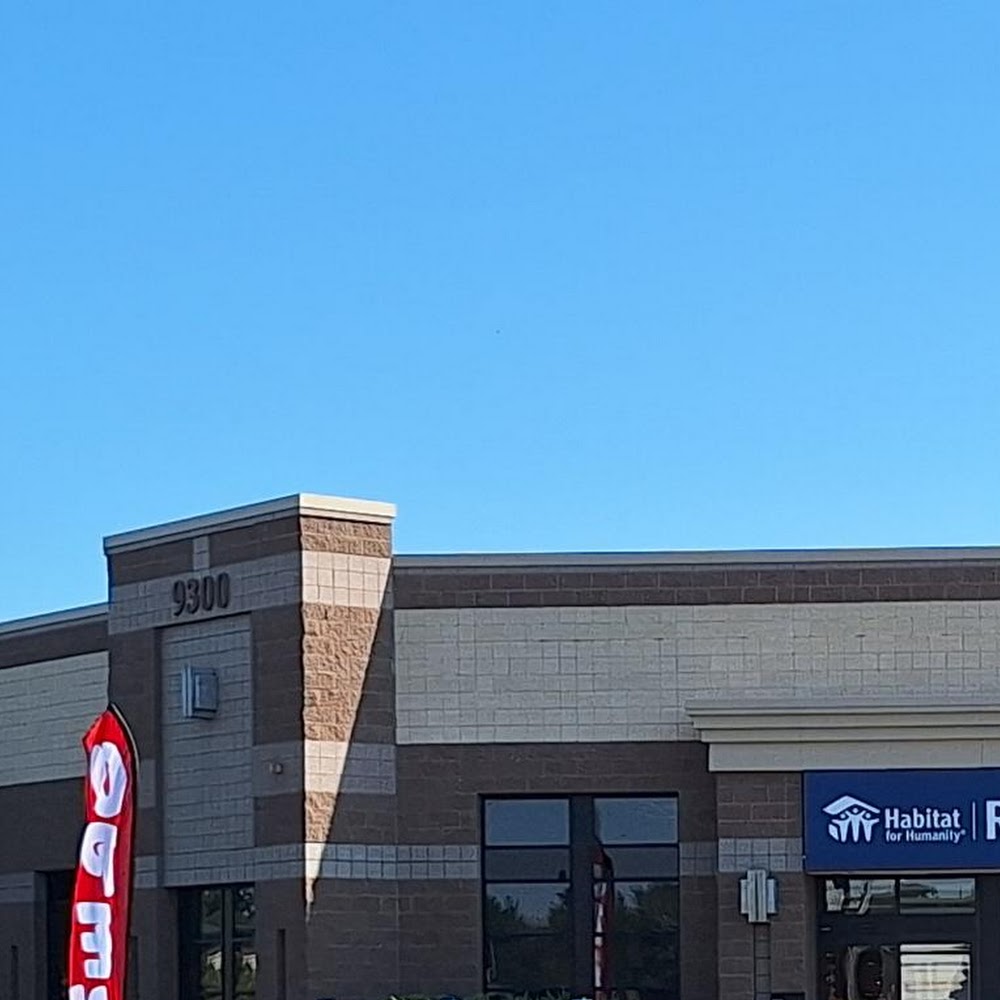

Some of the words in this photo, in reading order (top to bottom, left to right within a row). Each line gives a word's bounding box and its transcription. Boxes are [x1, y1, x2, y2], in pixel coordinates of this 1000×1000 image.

[173, 572, 230, 617] 9300
[884, 808, 961, 829] Habitat
[886, 829, 905, 842] for
[905, 829, 961, 844] Humanity
